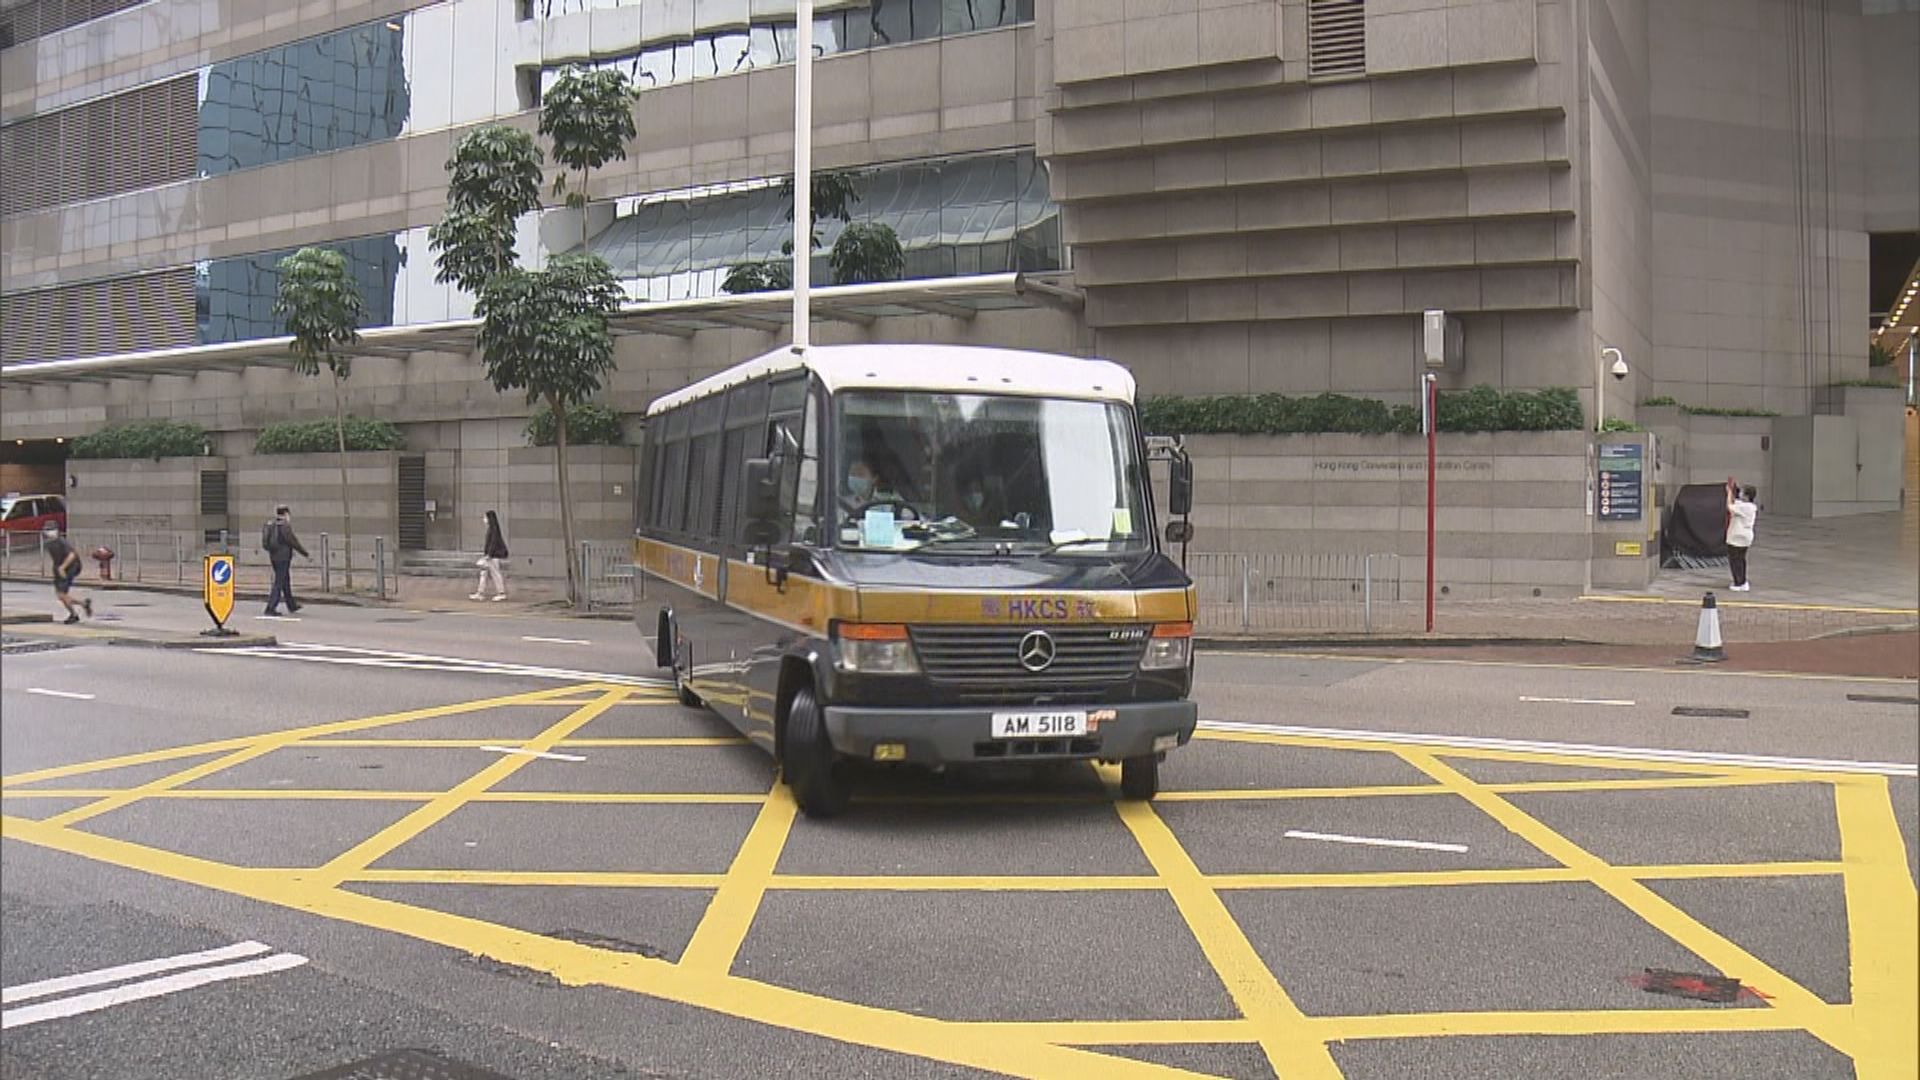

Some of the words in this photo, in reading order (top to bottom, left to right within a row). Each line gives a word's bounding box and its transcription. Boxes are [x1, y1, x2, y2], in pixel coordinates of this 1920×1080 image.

[1314, 461, 1336, 472] Hong
[1008, 600, 1068, 619] HKCS
[1005, 717, 1029, 733] AM
[1038, 716, 1076, 732] 5118
